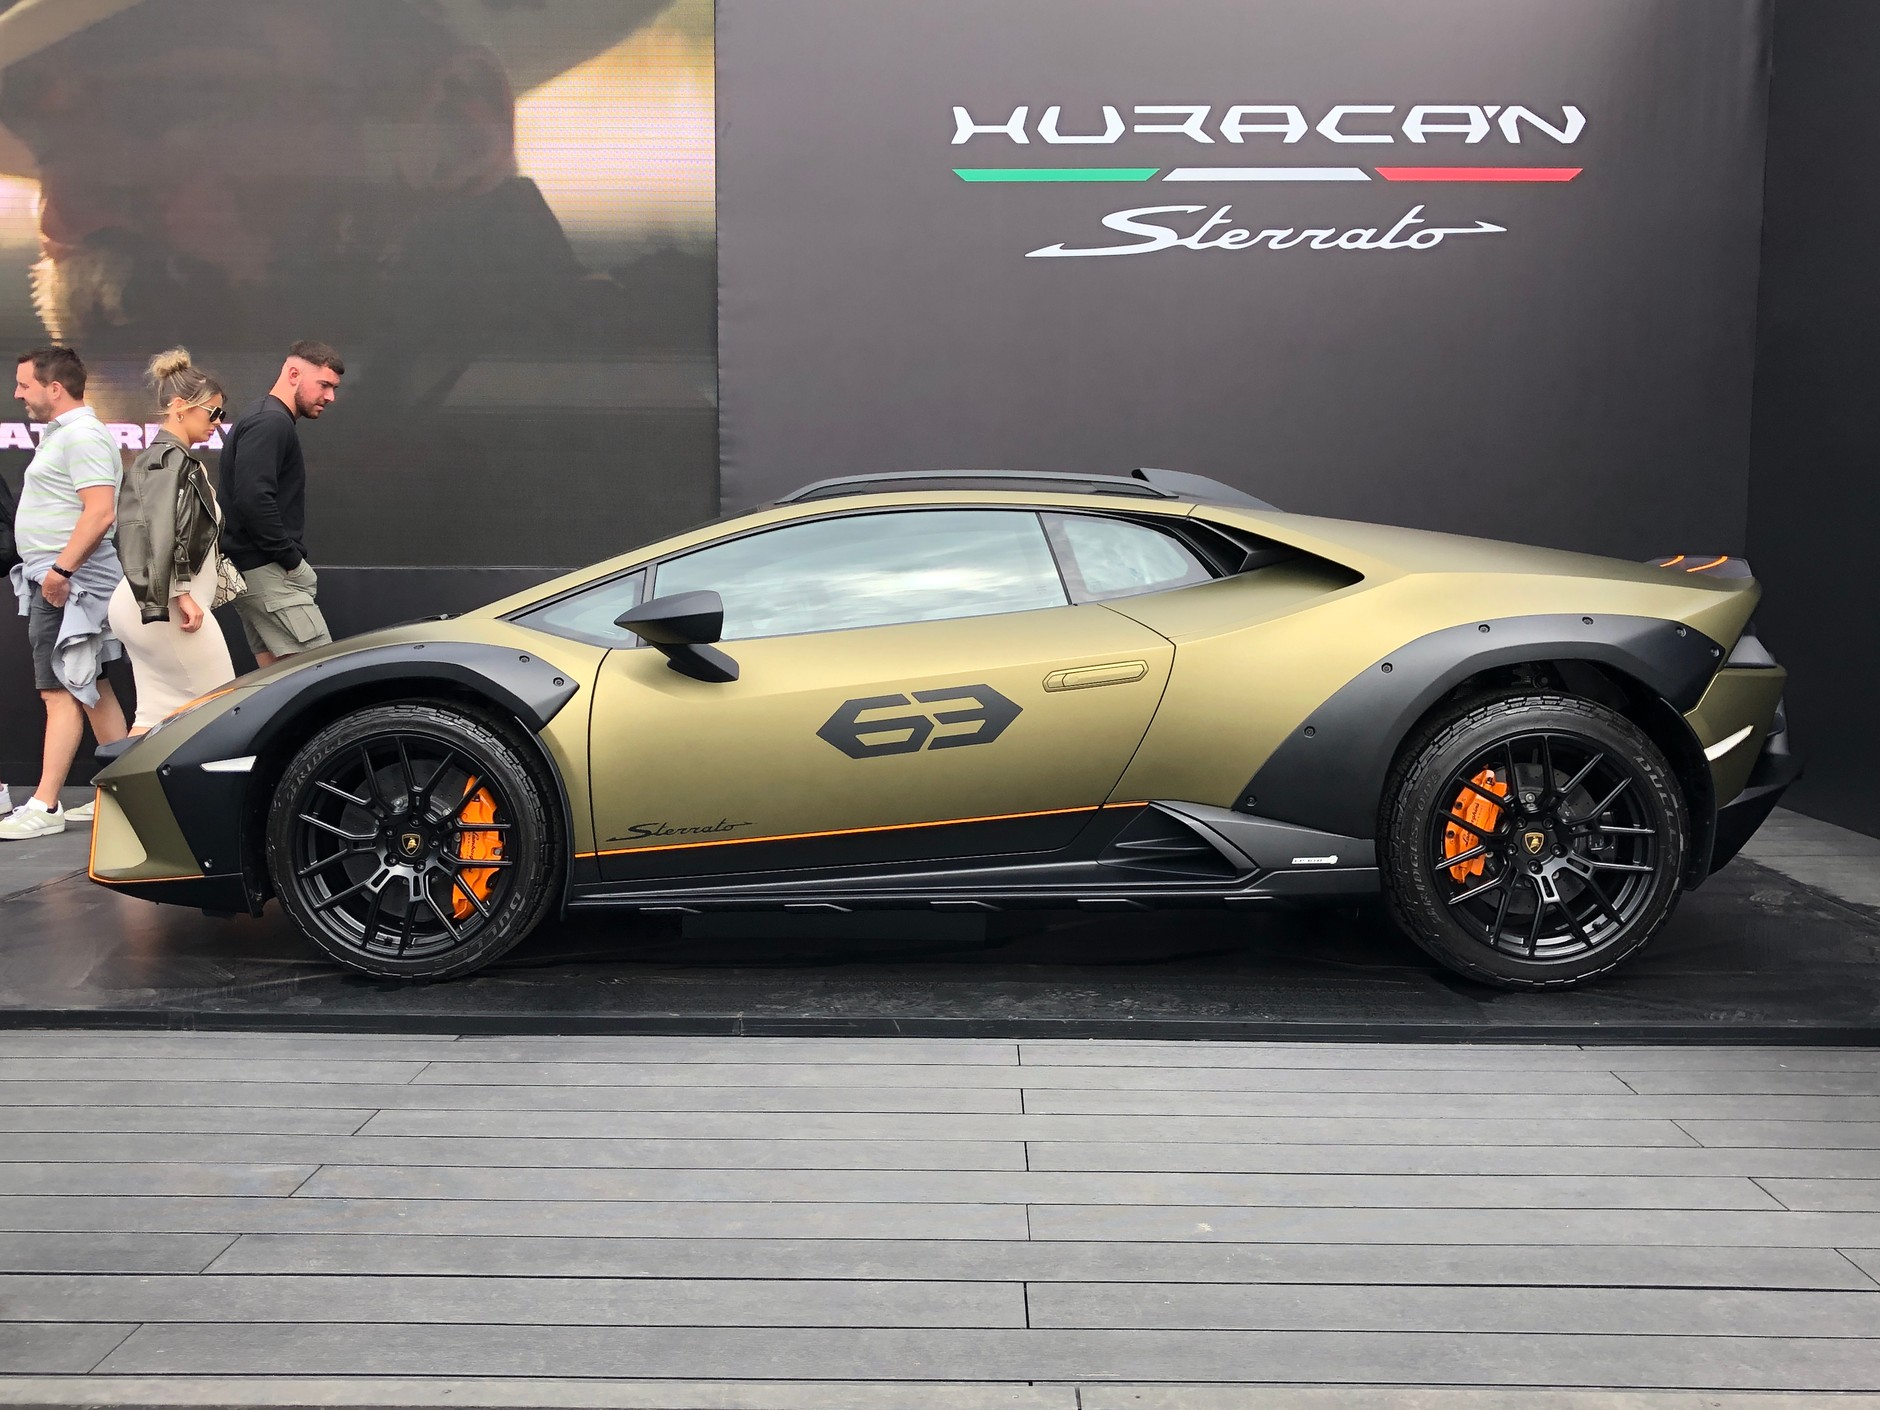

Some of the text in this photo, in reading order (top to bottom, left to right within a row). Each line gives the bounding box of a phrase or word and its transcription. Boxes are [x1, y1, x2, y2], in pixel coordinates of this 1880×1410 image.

[1025, 204, 1508, 258] Sterrato
[815, 683, 1023, 760] 63
[606, 818, 757, 842] Sterrato
